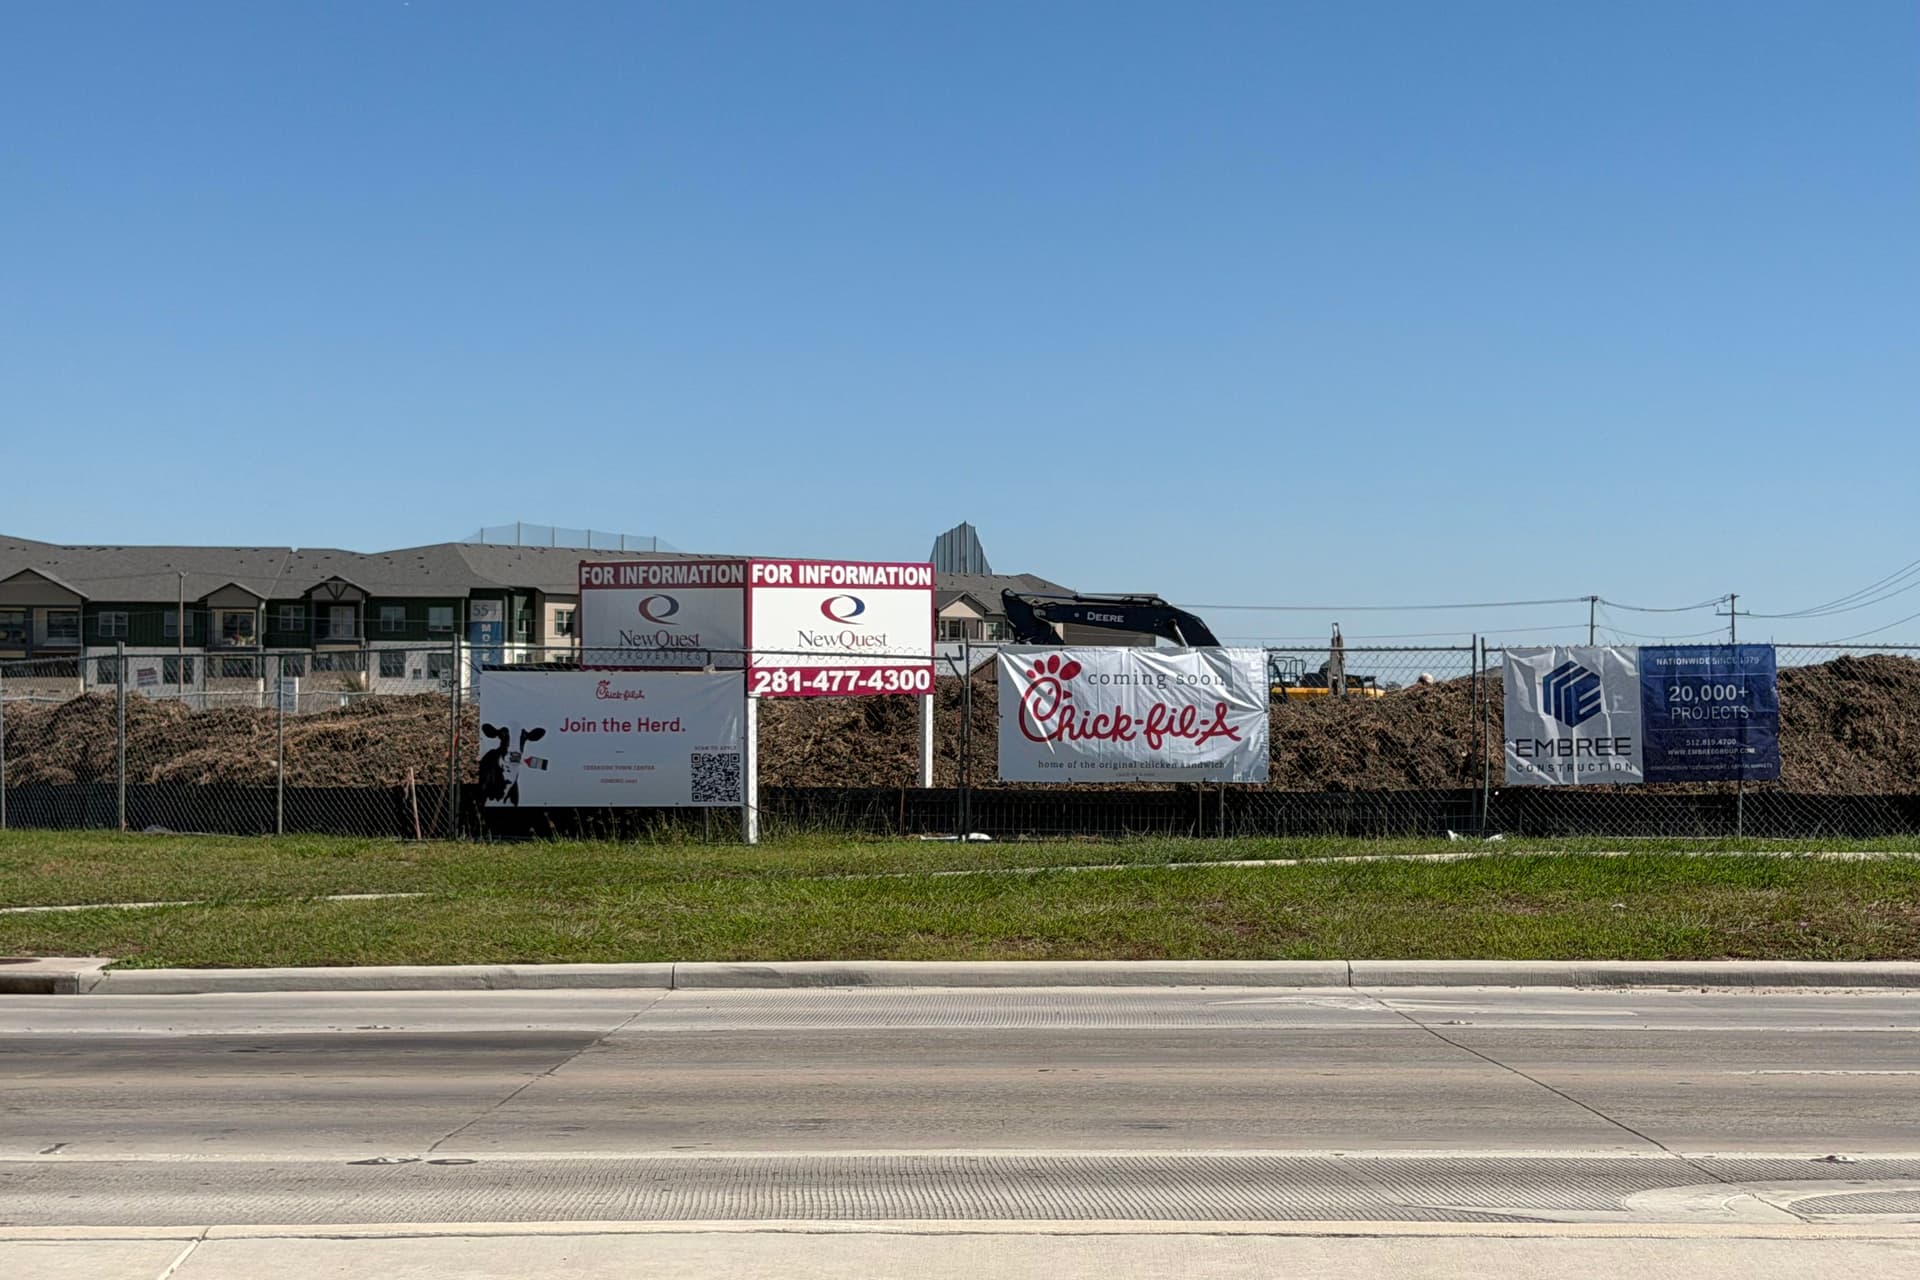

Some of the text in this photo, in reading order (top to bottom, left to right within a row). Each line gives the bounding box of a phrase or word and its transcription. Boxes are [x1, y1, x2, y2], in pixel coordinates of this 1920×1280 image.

[581, 565, 744, 585] FOR INFORMATION
[752, 564, 932, 587] FOR INFORMATION
[1086, 611, 1125, 623] DEERE
[619, 630, 701, 648] NewQuest
[797, 630, 888, 650] NewQuest
[1656, 657, 1710, 666] NATIONWIDE
[754, 669, 931, 693] 281-477-4300
[1087, 670, 1226, 690] coming soon
[1668, 684, 1749, 704] 20,000+
[1018, 676, 1242, 750] Chick-fil-A
[1671, 705, 1750, 720] PROJECTS
[560, 717, 686, 733] Join the Herd.
[1515, 737, 1632, 757] EMBREE
[1038, 759, 1064, 769] home
[1067, 760, 1078, 769] of
[1080, 760, 1096, 769] the
[1099, 760, 1137, 770] original
[1140, 760, 1177, 769] chicken
[1516, 762, 1633, 773] CONSTRUCTION
